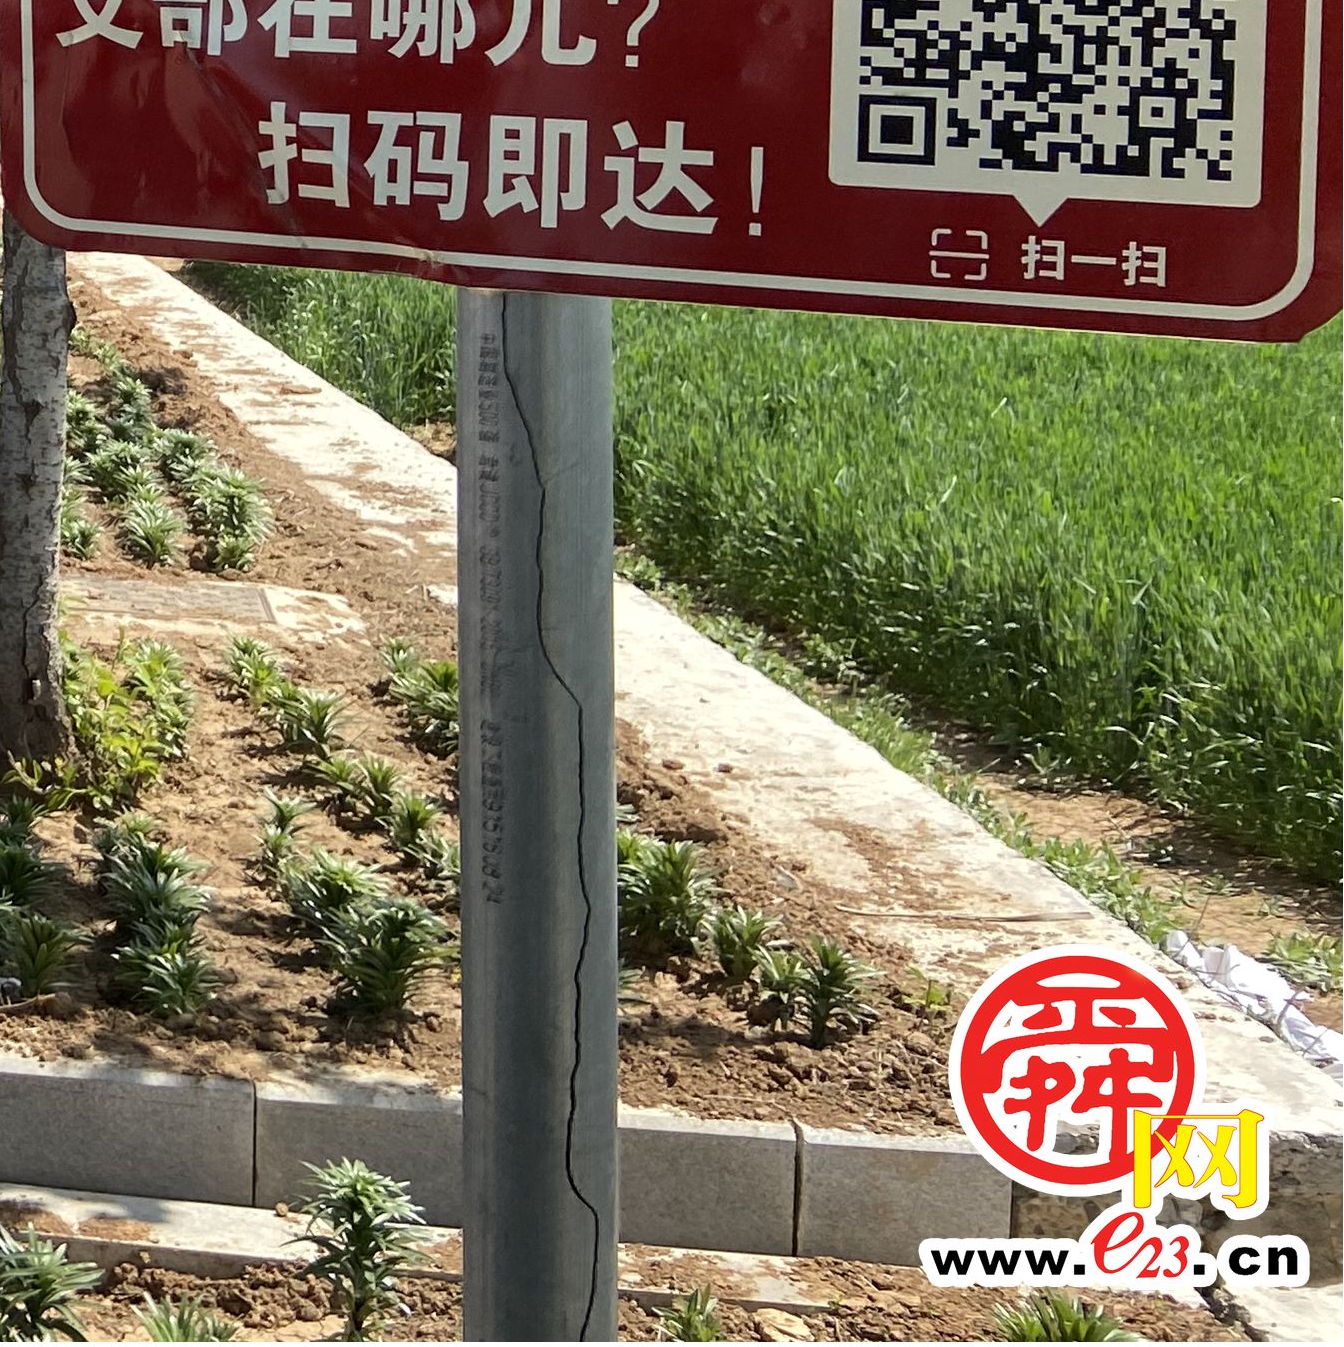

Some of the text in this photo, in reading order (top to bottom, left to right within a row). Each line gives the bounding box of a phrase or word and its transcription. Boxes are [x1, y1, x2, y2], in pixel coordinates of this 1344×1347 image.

[258, 101, 766, 238] 扫码即达！
[1019, 234, 1168, 290] 扫一扫
